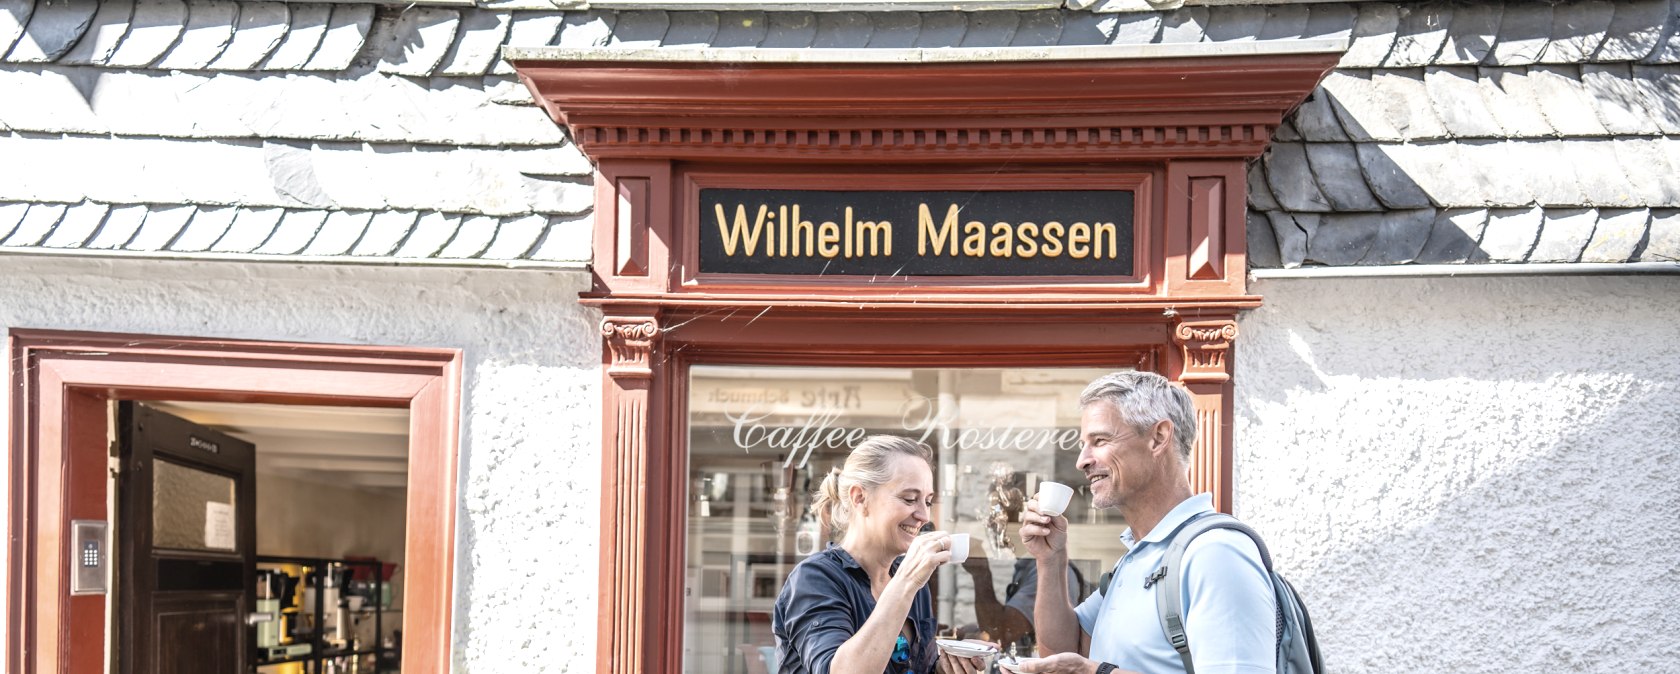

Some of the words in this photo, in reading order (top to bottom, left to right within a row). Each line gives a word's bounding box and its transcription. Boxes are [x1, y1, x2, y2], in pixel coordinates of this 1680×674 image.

[714, 202, 892, 259] Wilhelm
[917, 202, 1118, 259] Maassen
[725, 402, 866, 469] Caffee
